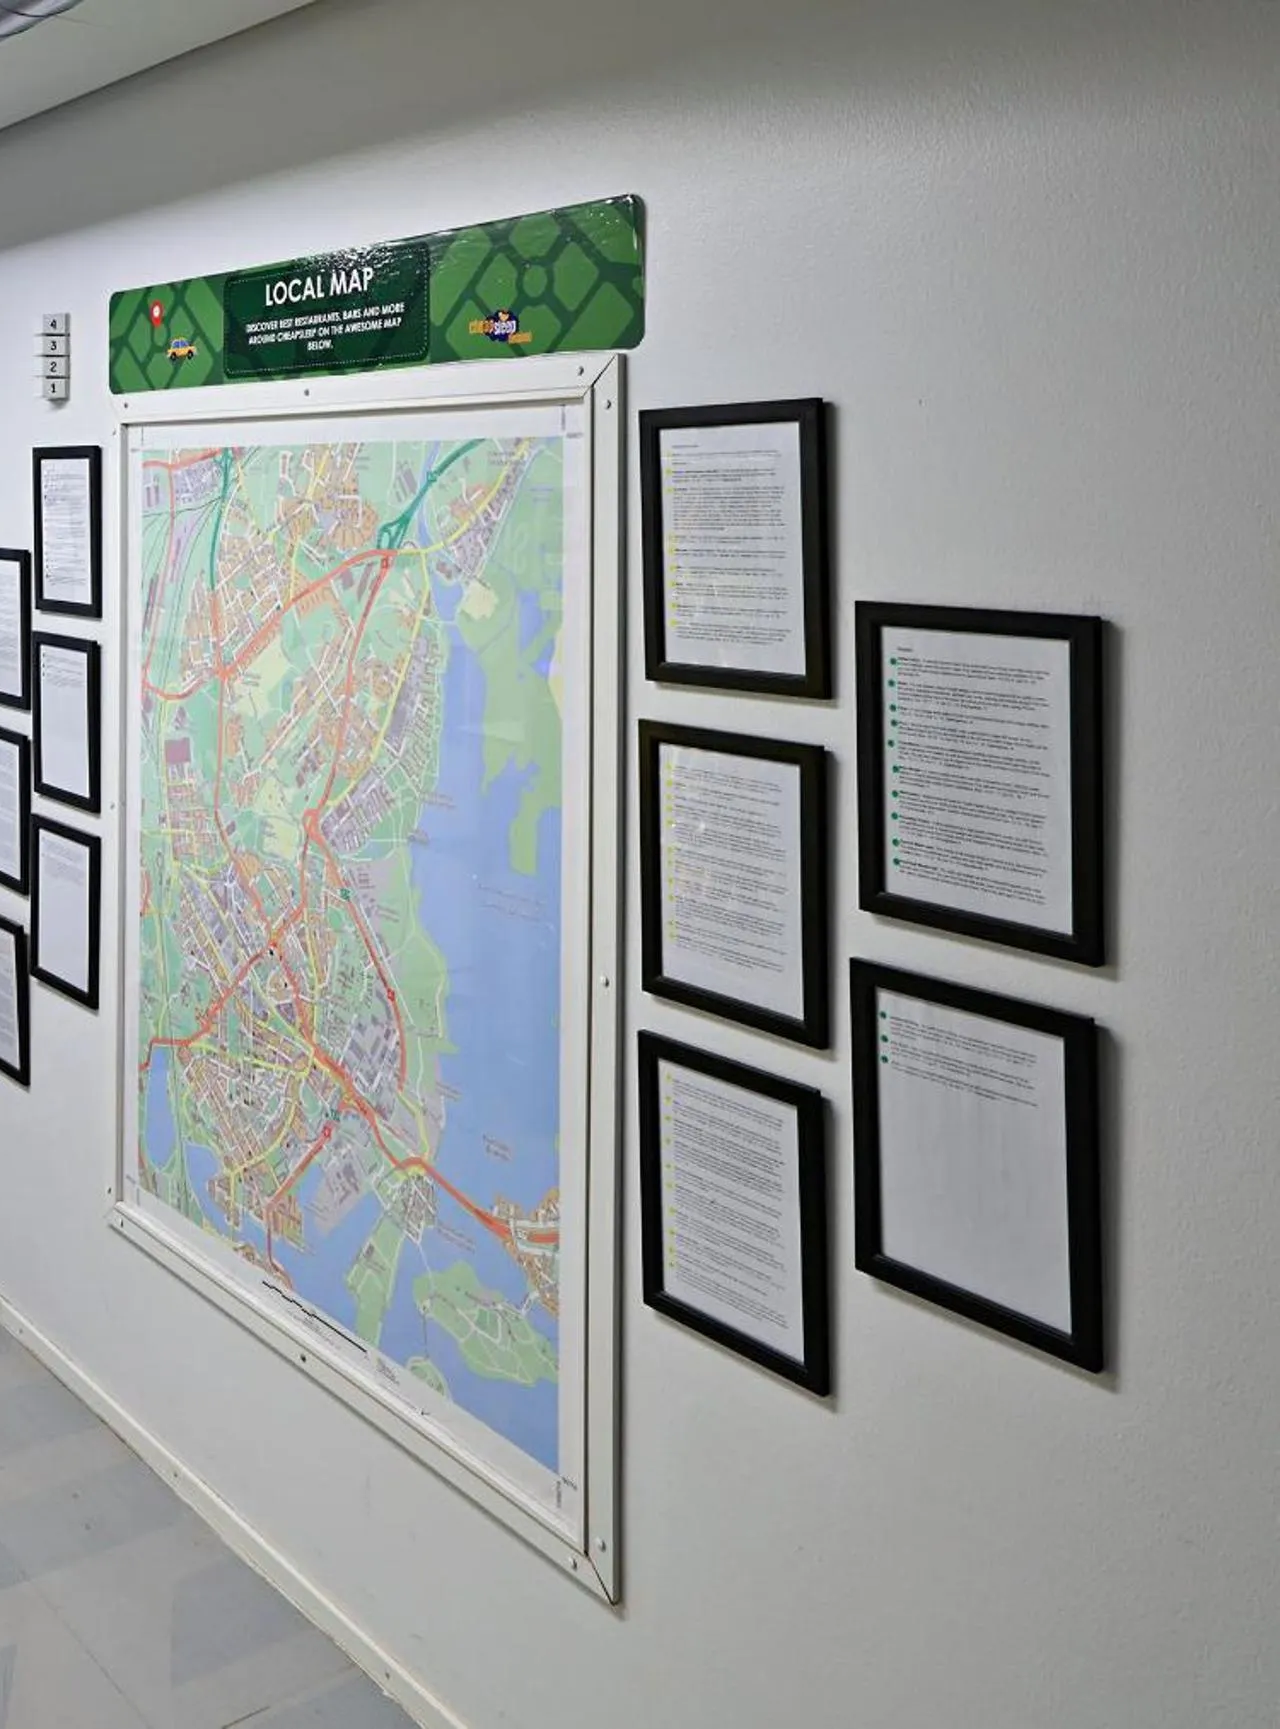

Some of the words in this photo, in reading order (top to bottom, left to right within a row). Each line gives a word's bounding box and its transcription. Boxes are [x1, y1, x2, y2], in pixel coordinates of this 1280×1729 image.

[265, 274, 325, 306] LOCAL
[329, 267, 374, 296] MAP
[246, 319, 278, 333] DISCOVER
[279, 317, 293, 329] BEST
[343, 308, 362, 320] BARS
[363, 305, 380, 317] AND
[381, 302, 405, 315] MORE
[50, 319, 57, 330] 4
[248, 331, 276, 345] AROUND
[318, 326, 330, 337] ON
[331, 324, 344, 336] THE
[344, 319, 383, 334] AWESOME
[383, 317, 402, 329] MAP
[50, 341, 57, 351] 3
[307, 339, 334, 351] BELOW.
[50, 362, 57, 373] 2
[51, 383, 56, 393] 1
